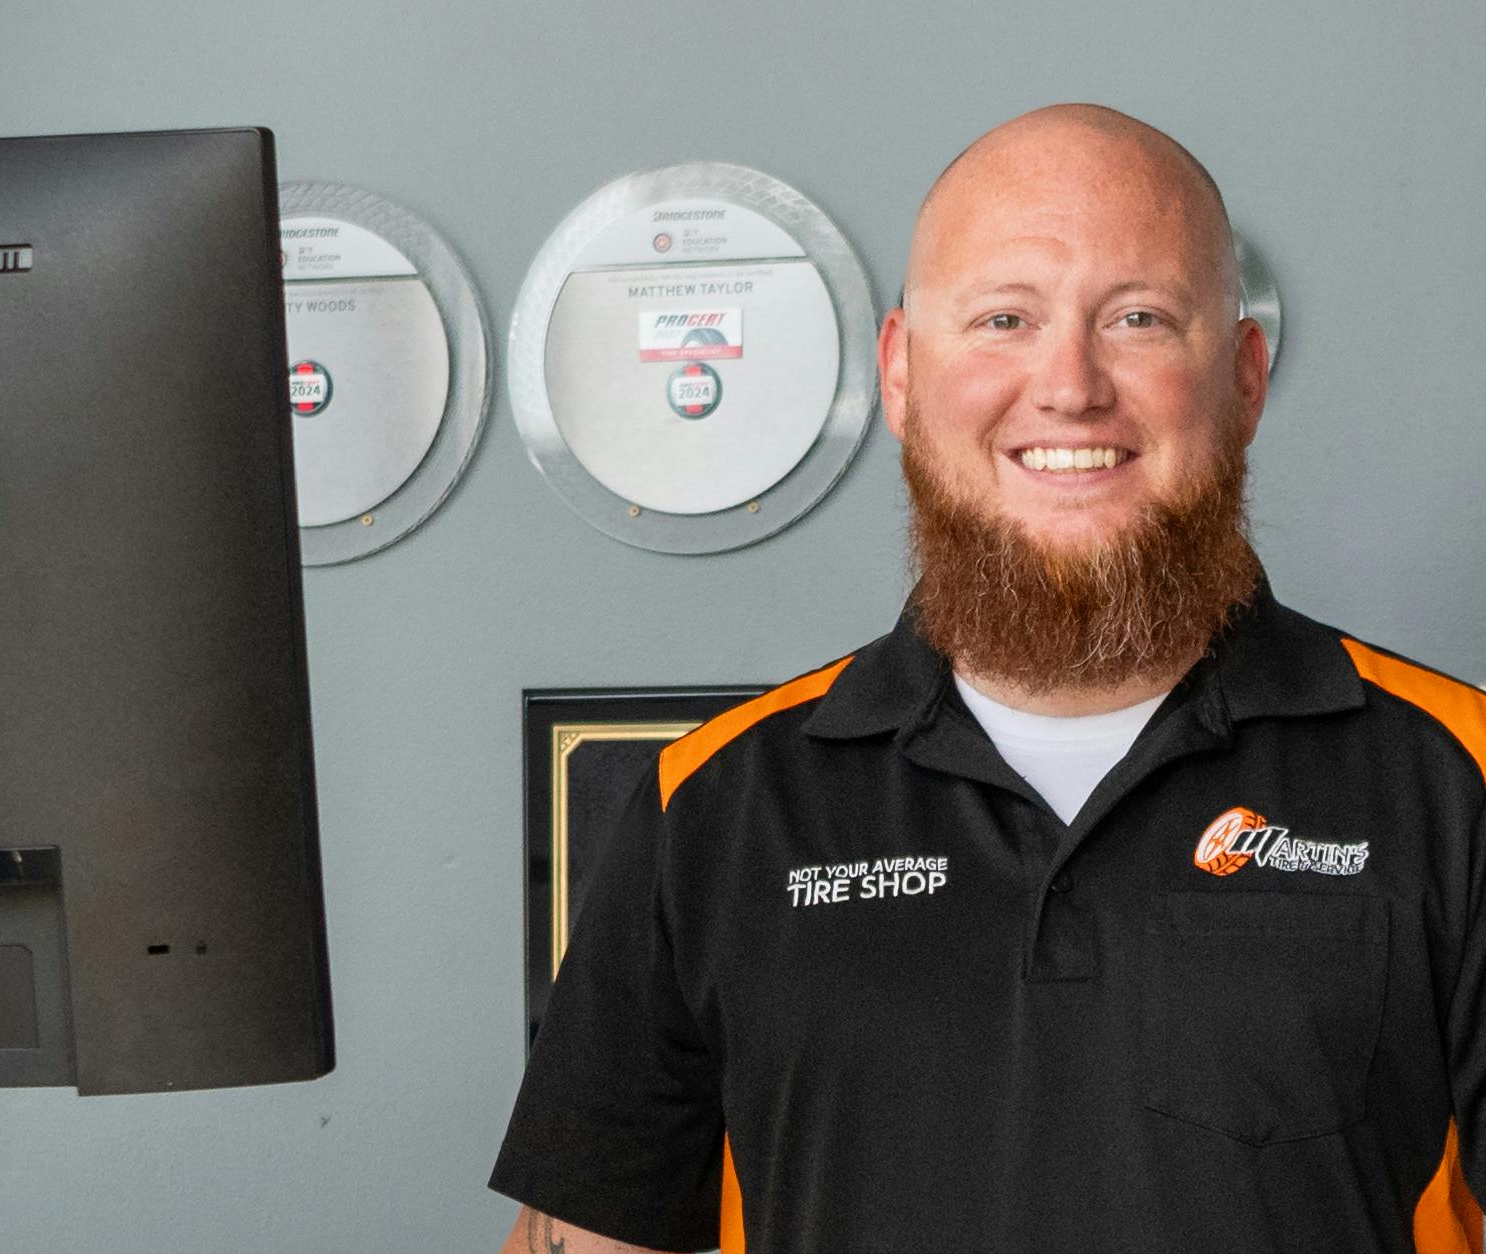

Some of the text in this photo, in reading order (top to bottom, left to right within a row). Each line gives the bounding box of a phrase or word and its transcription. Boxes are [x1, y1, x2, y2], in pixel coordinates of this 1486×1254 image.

[653, 209, 728, 223] BRIDGESTONE
[281, 227, 341, 240] RIDGESTONE
[682, 237, 728, 246] EDUCATION
[298, 254, 342, 263] EDUCATION
[628, 281, 754, 299] MATTHEW TAYLOR
[306, 300, 356, 313] WOODS
[654, 311, 728, 328] PROCERT
[291, 385, 321, 397] 2024
[678, 386, 711, 400] 2024
[1226, 826, 1369, 867] MARTIN'S
[789, 857, 948, 884] NOT YOUR AVERAGE
[1269, 856, 1298, 872] TIRE
[786, 871, 946, 908] TIRE SHOP
